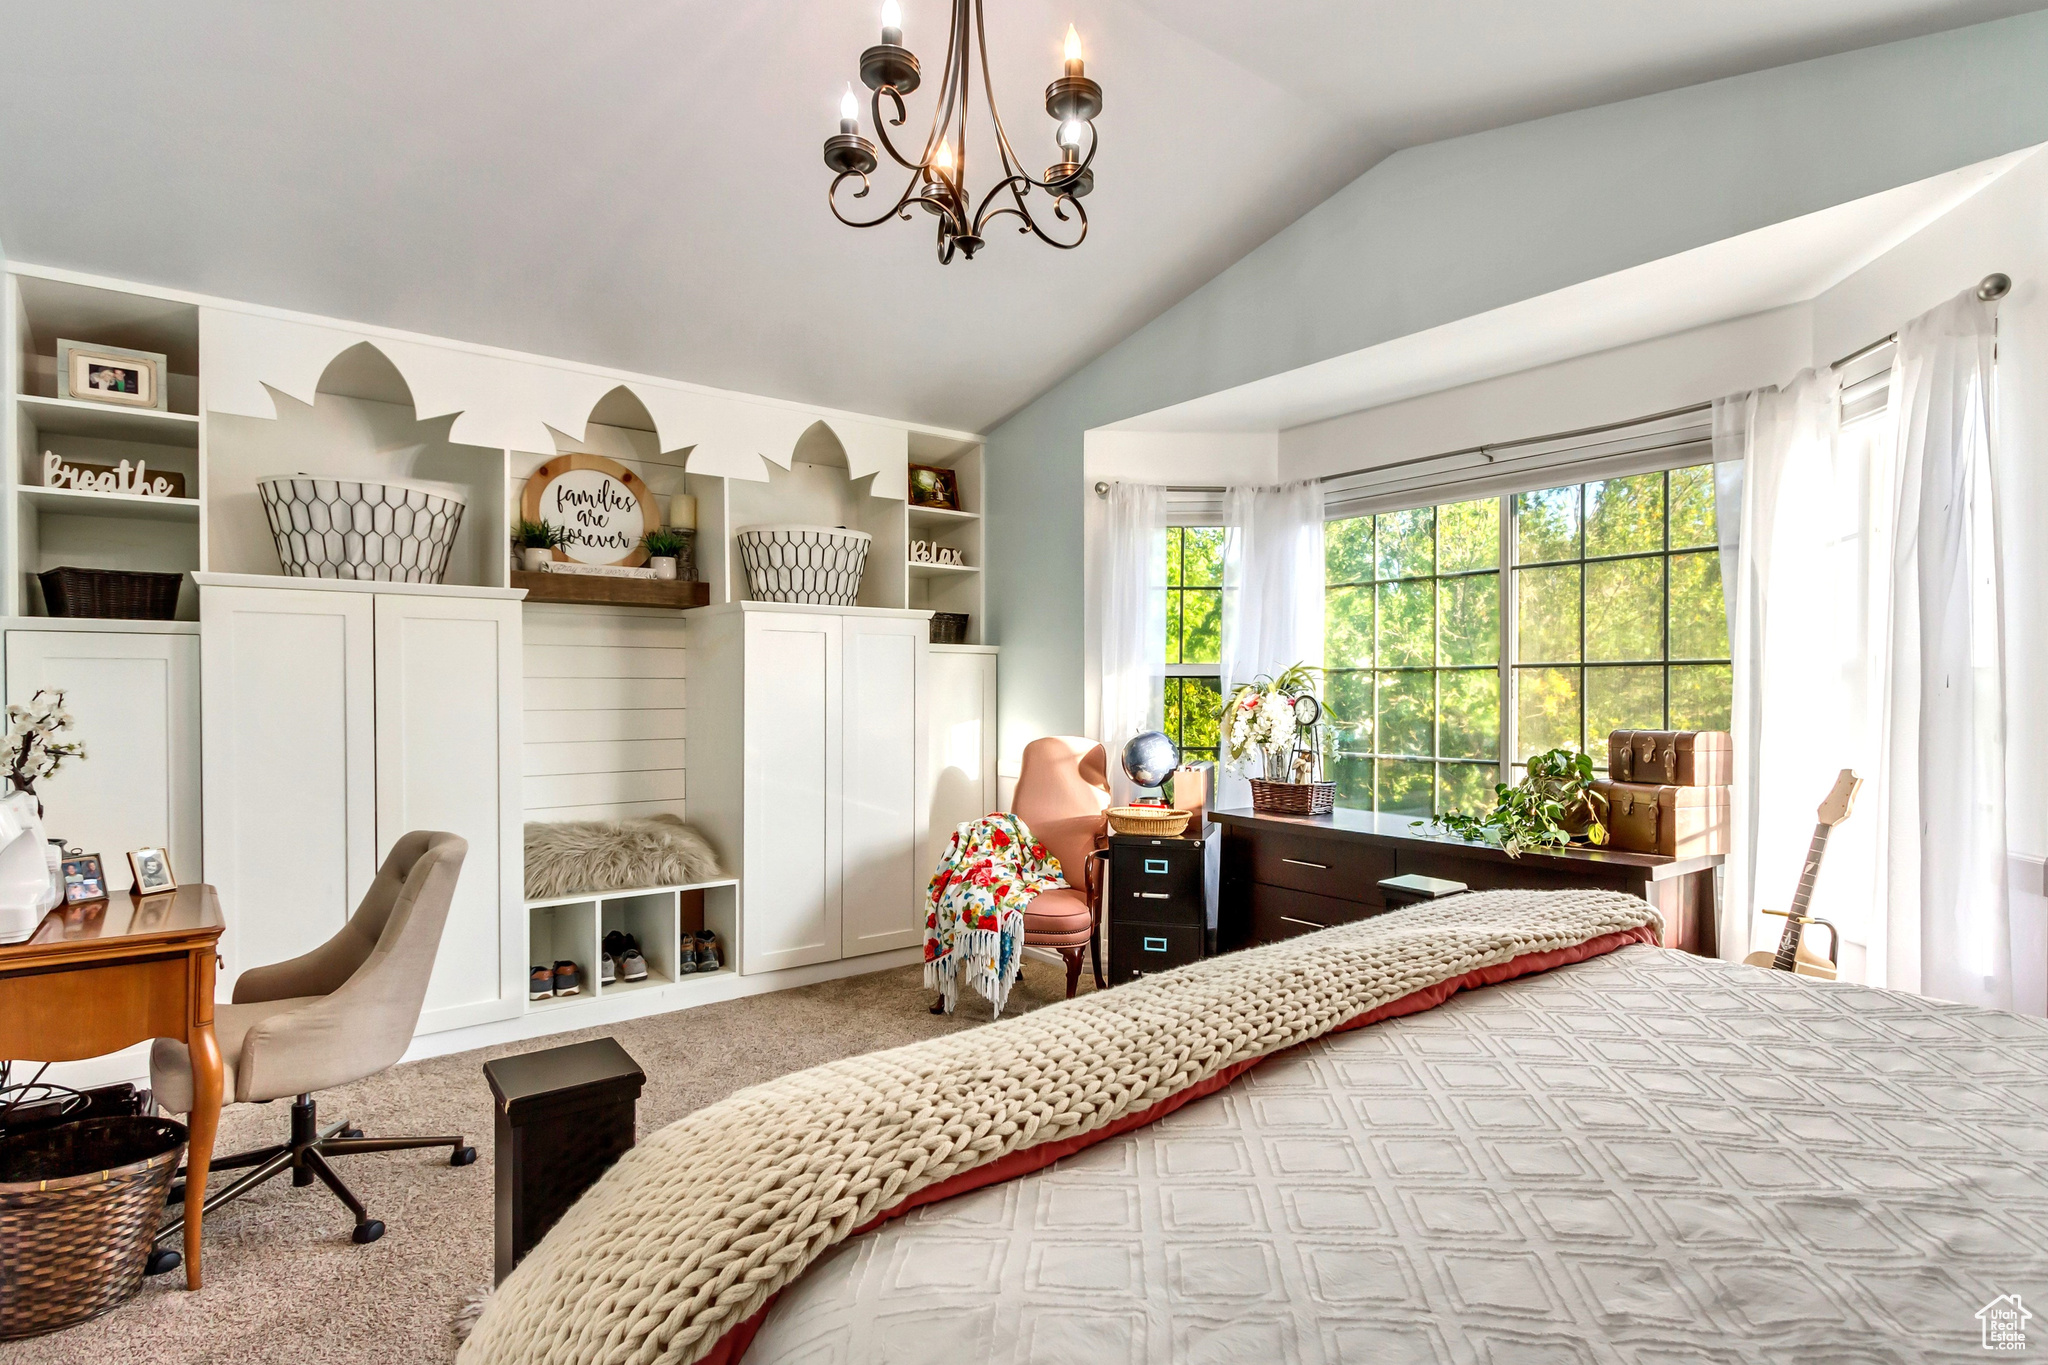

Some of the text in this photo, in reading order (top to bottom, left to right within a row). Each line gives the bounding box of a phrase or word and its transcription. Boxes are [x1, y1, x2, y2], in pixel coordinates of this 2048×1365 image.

[44, 450, 174, 497] Breathe
[557, 479, 637, 513] families
[577, 509, 609, 528] are
[559, 526, 630, 554] forever
[910, 540, 964, 566] Relax
